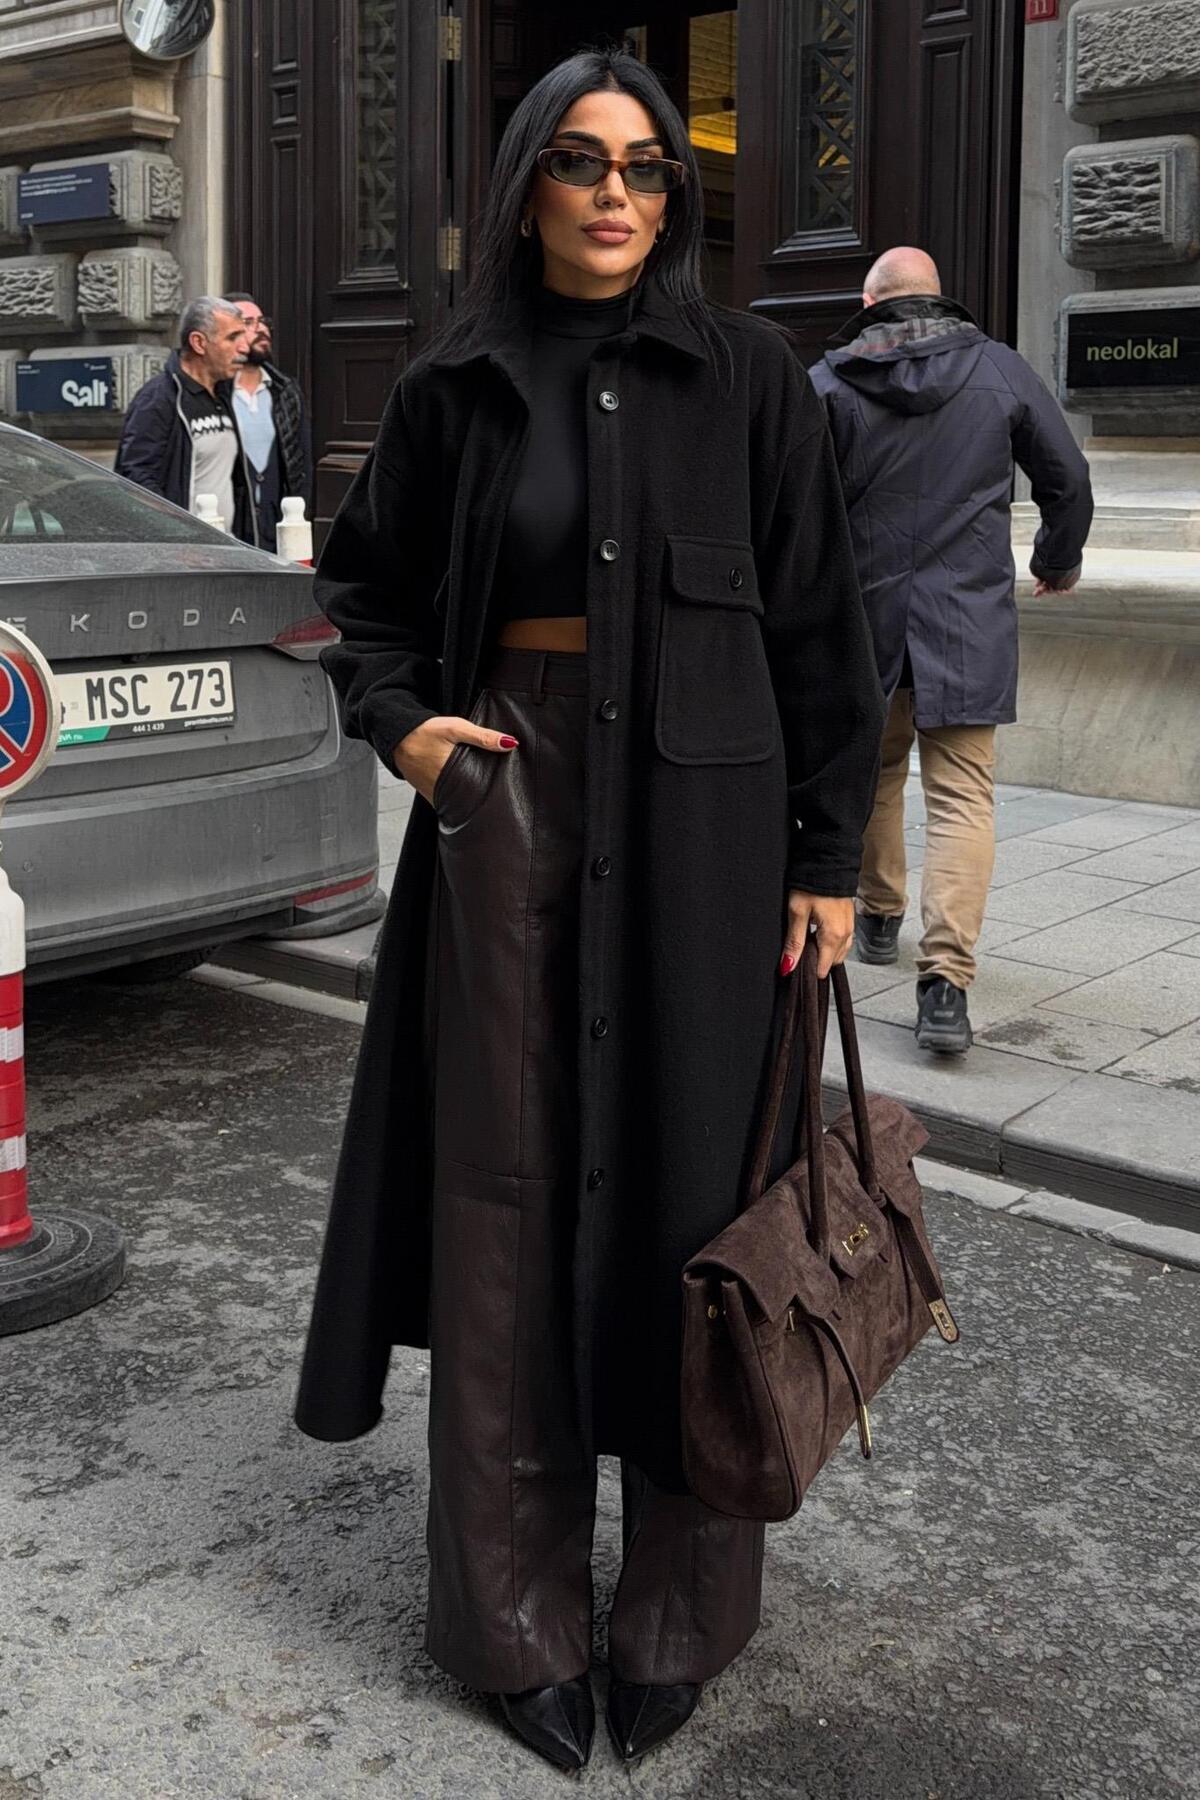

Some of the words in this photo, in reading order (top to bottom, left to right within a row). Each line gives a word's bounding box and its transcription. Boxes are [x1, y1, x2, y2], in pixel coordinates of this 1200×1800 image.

[1086, 337, 1179, 361] neolokal
[61, 379, 109, 407] Salt
[85, 674, 151, 721] MSC
[167, 668, 227, 713] 273
[132, 724, 146, 733] 444
